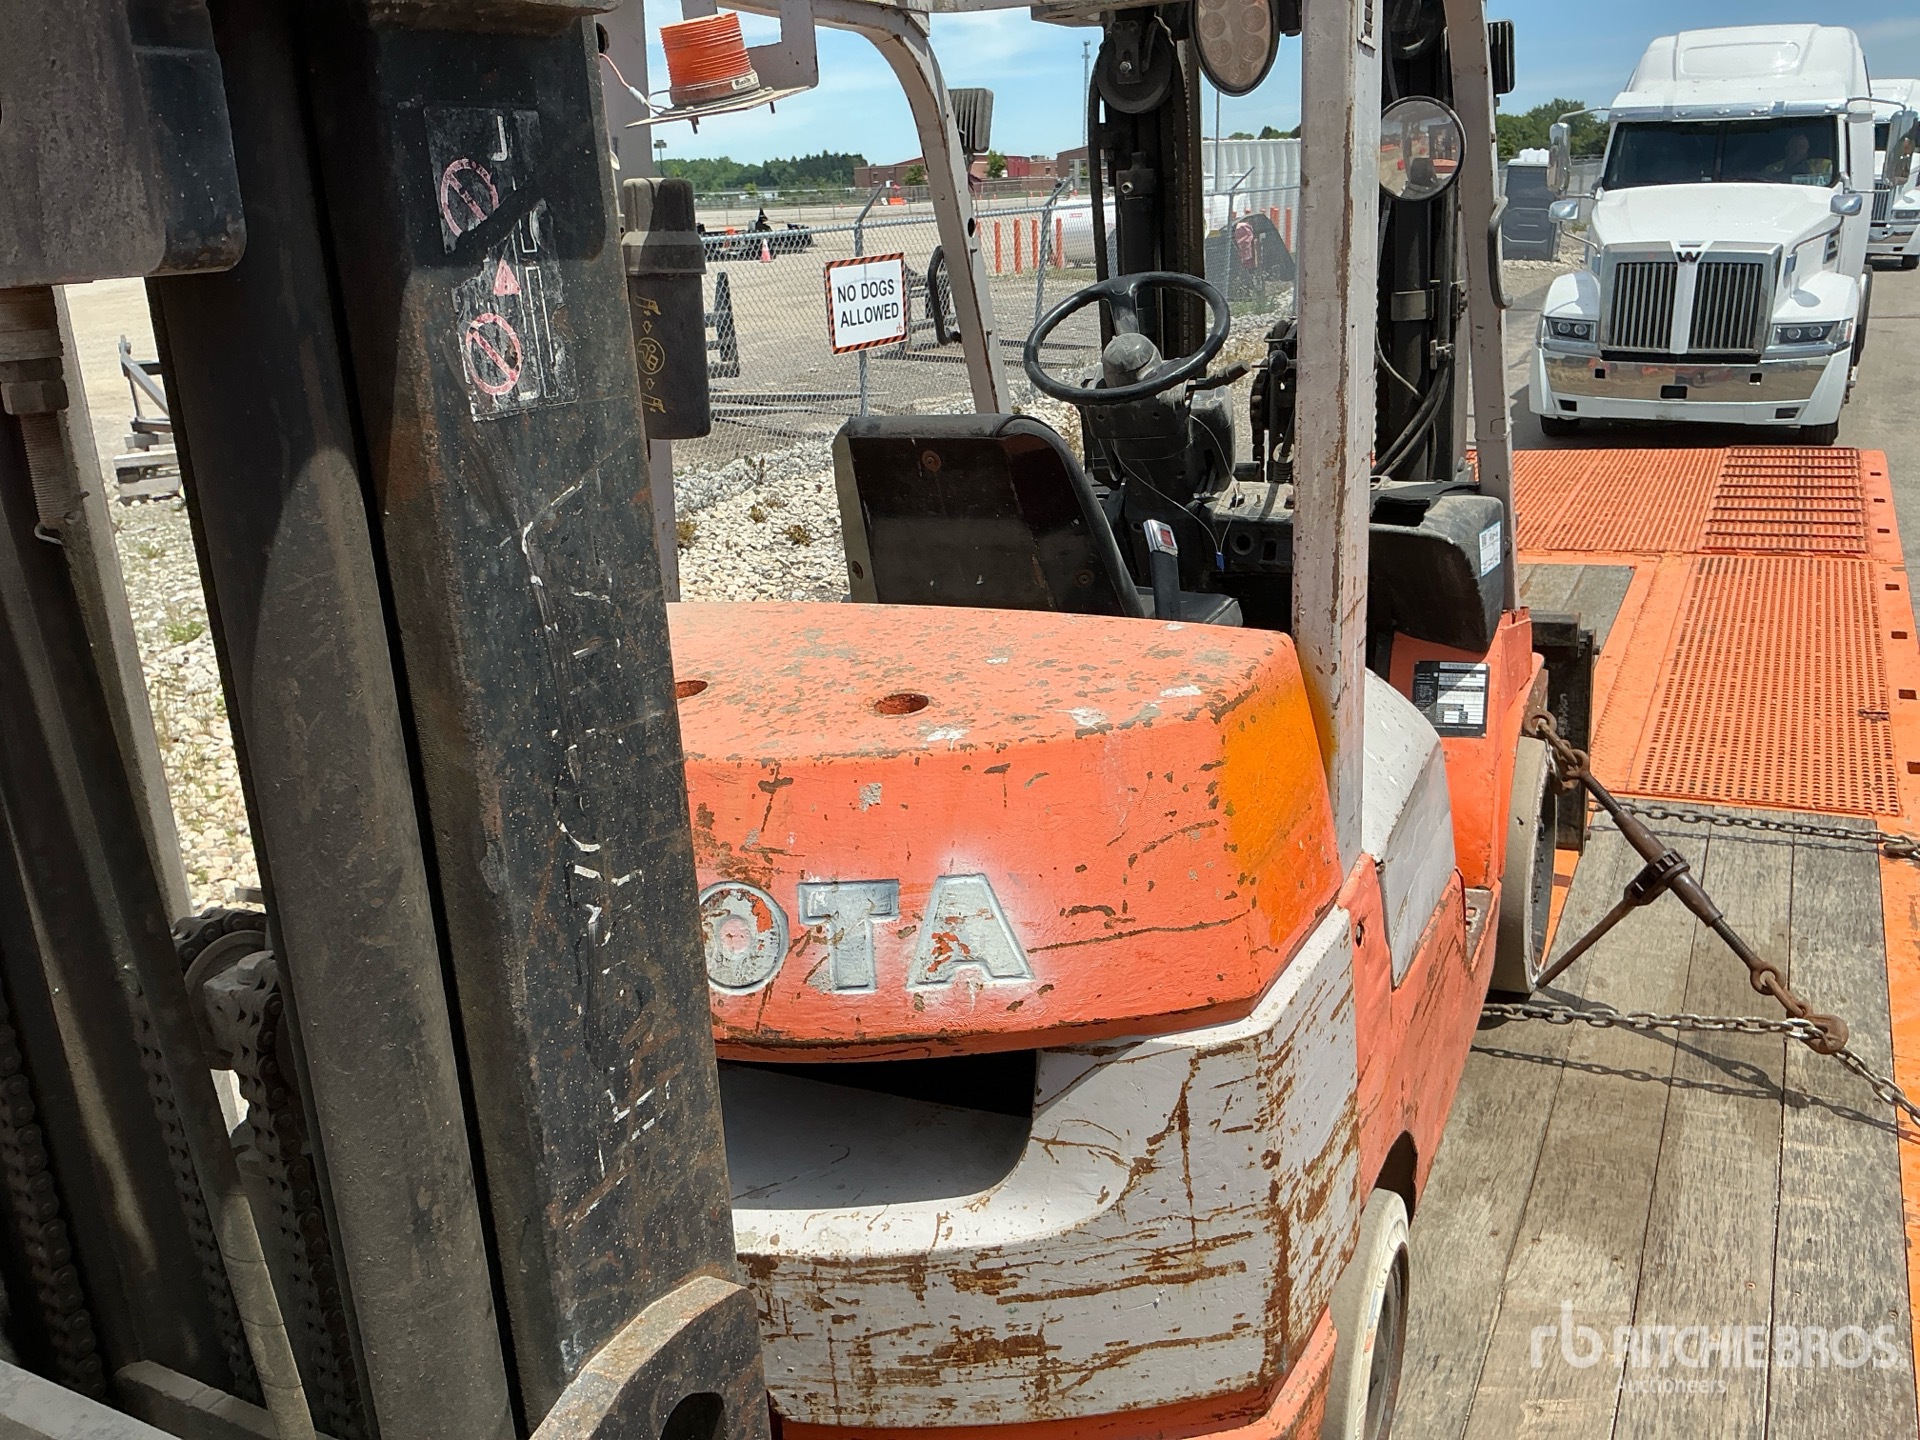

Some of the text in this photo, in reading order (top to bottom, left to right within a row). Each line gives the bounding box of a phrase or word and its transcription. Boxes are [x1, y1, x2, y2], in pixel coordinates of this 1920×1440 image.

[837, 278, 895, 304] NO DOGS
[840, 302, 899, 329] ALLOWED
